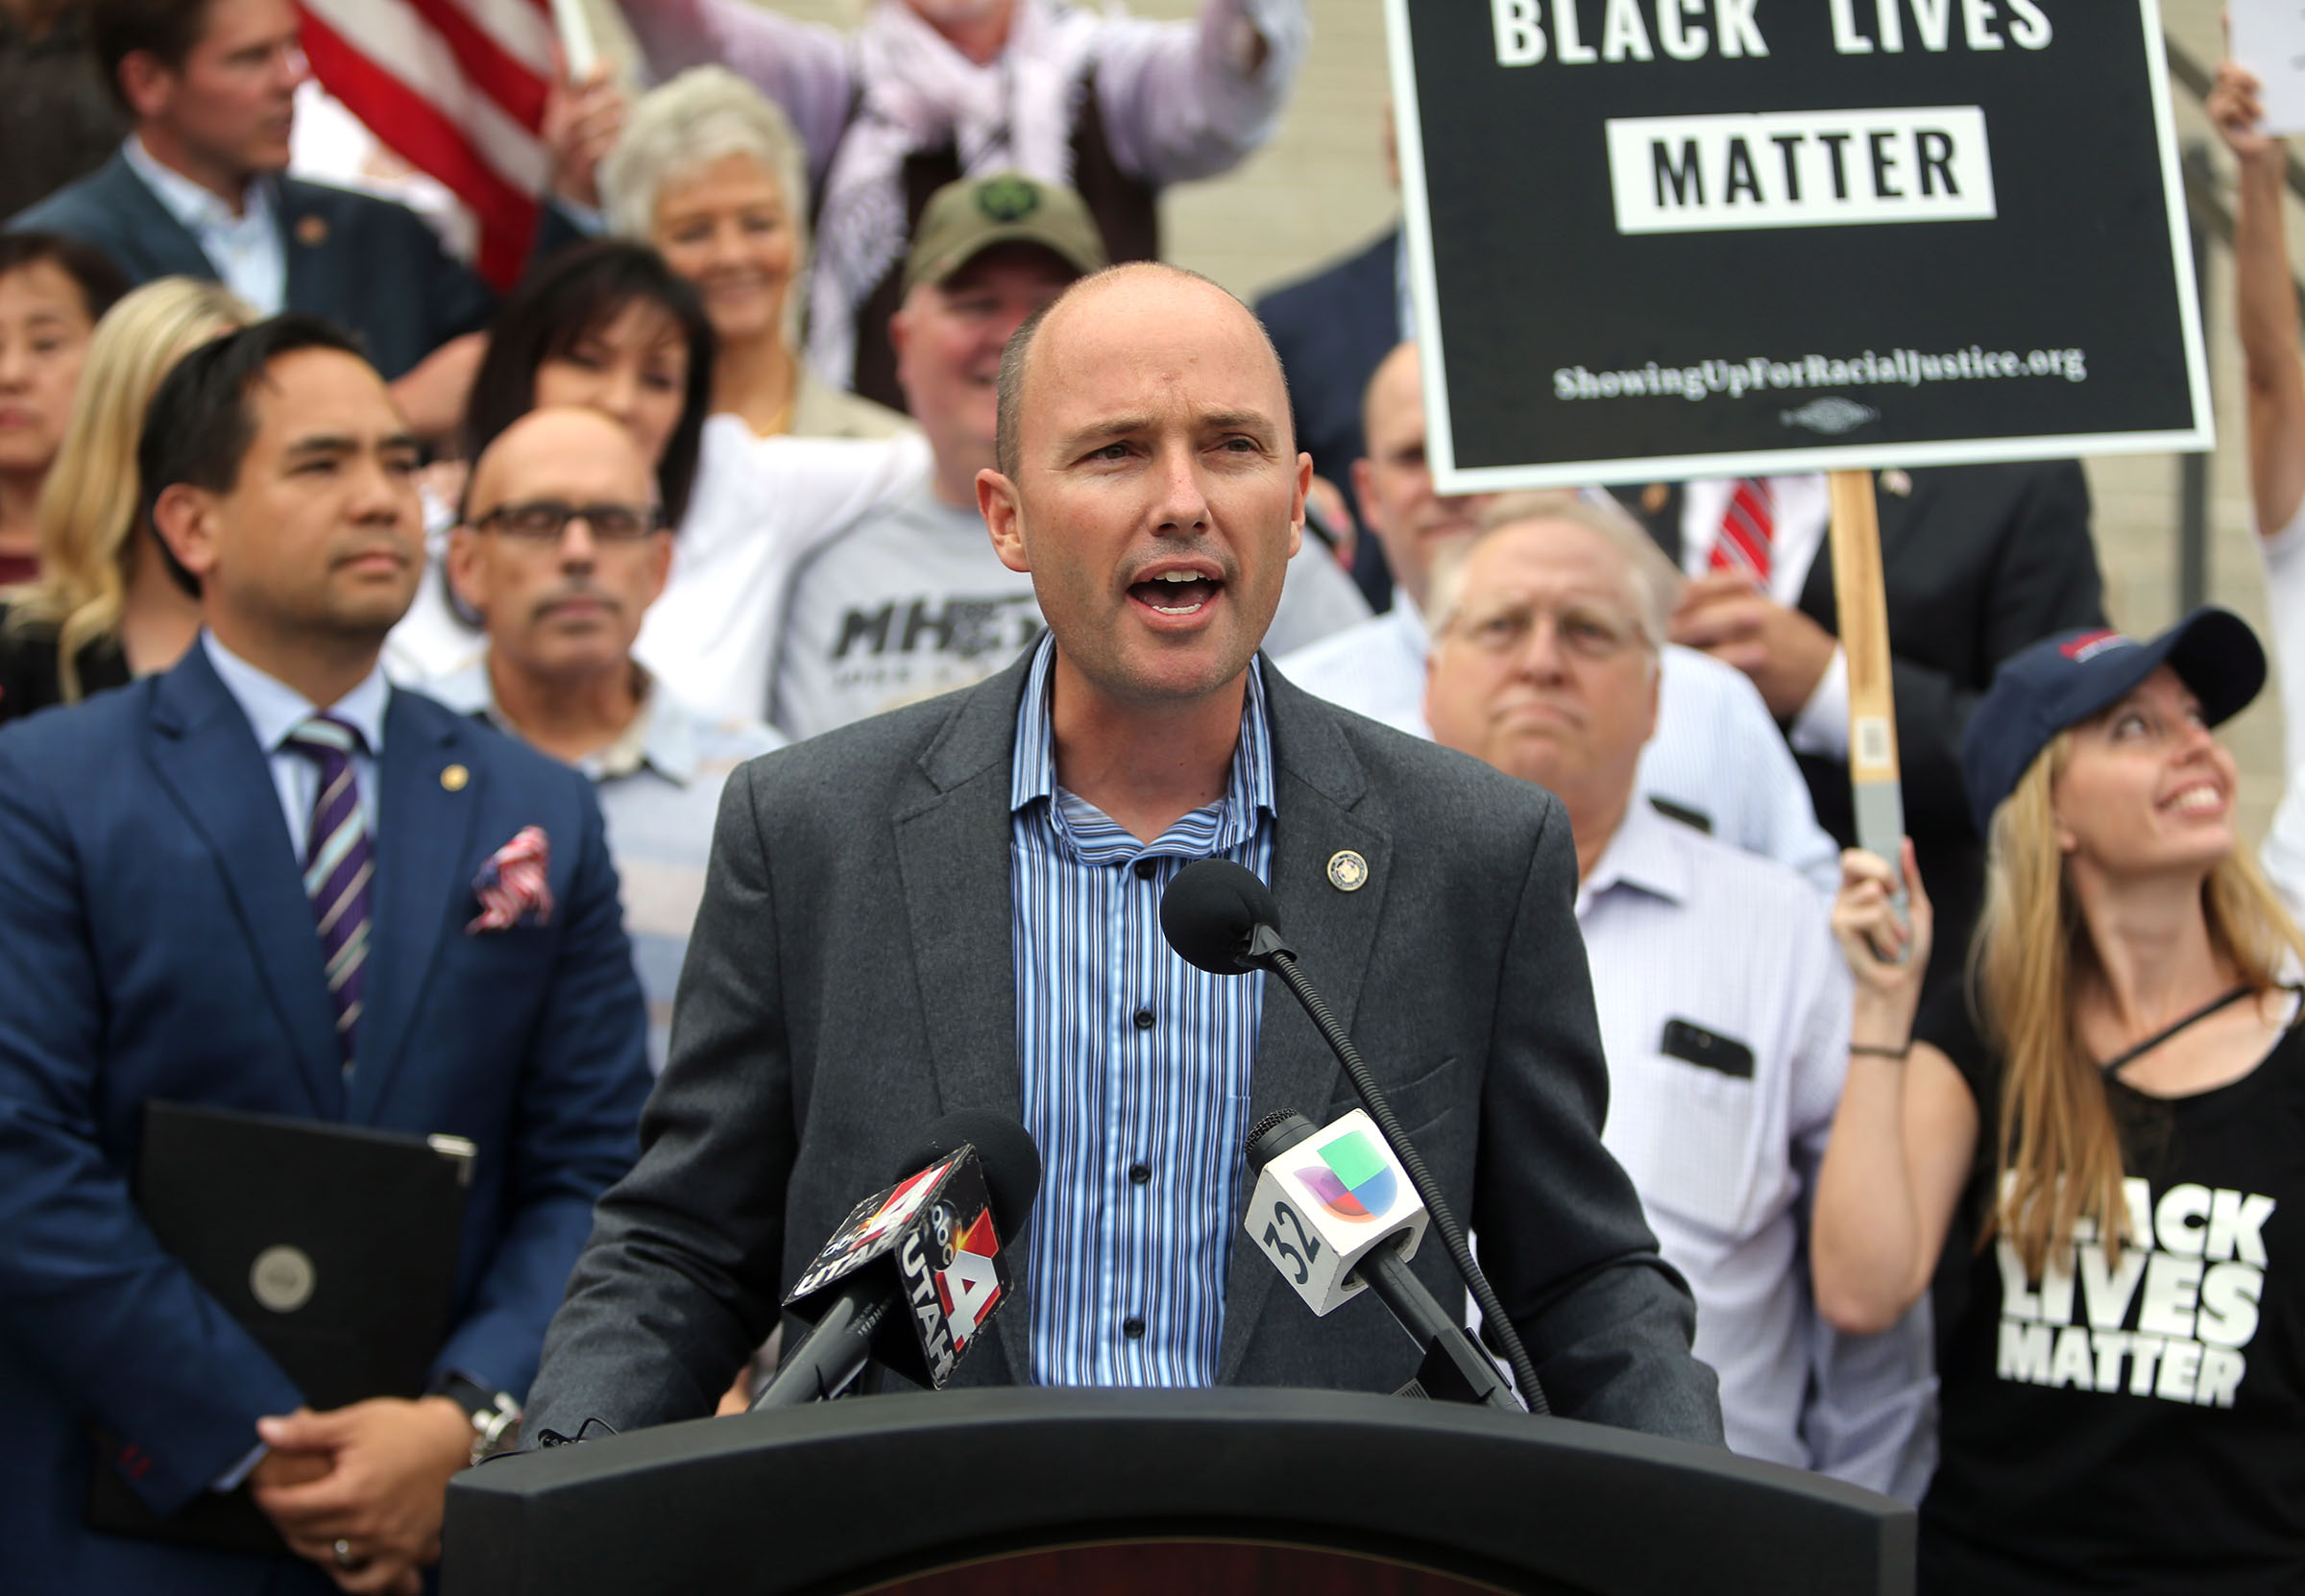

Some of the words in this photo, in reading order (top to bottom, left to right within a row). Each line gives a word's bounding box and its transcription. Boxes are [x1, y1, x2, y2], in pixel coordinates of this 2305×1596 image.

[1491, 0, 1770, 67] BLACK
[1830, 0, 2053, 55] LIVES
[1650, 127, 1963, 209] MATTER
[1553, 345, 2087, 401] ShowingUpForRacialJustice.org
[792, 1224, 905, 1296] UTAH
[931, 1204, 955, 1267] abc
[1262, 1200, 1322, 1285] 32
[901, 1230, 956, 1378] UTAH
[1996, 1245, 2265, 1350] LIVES
[1996, 1319, 2246, 1410] MATTER
